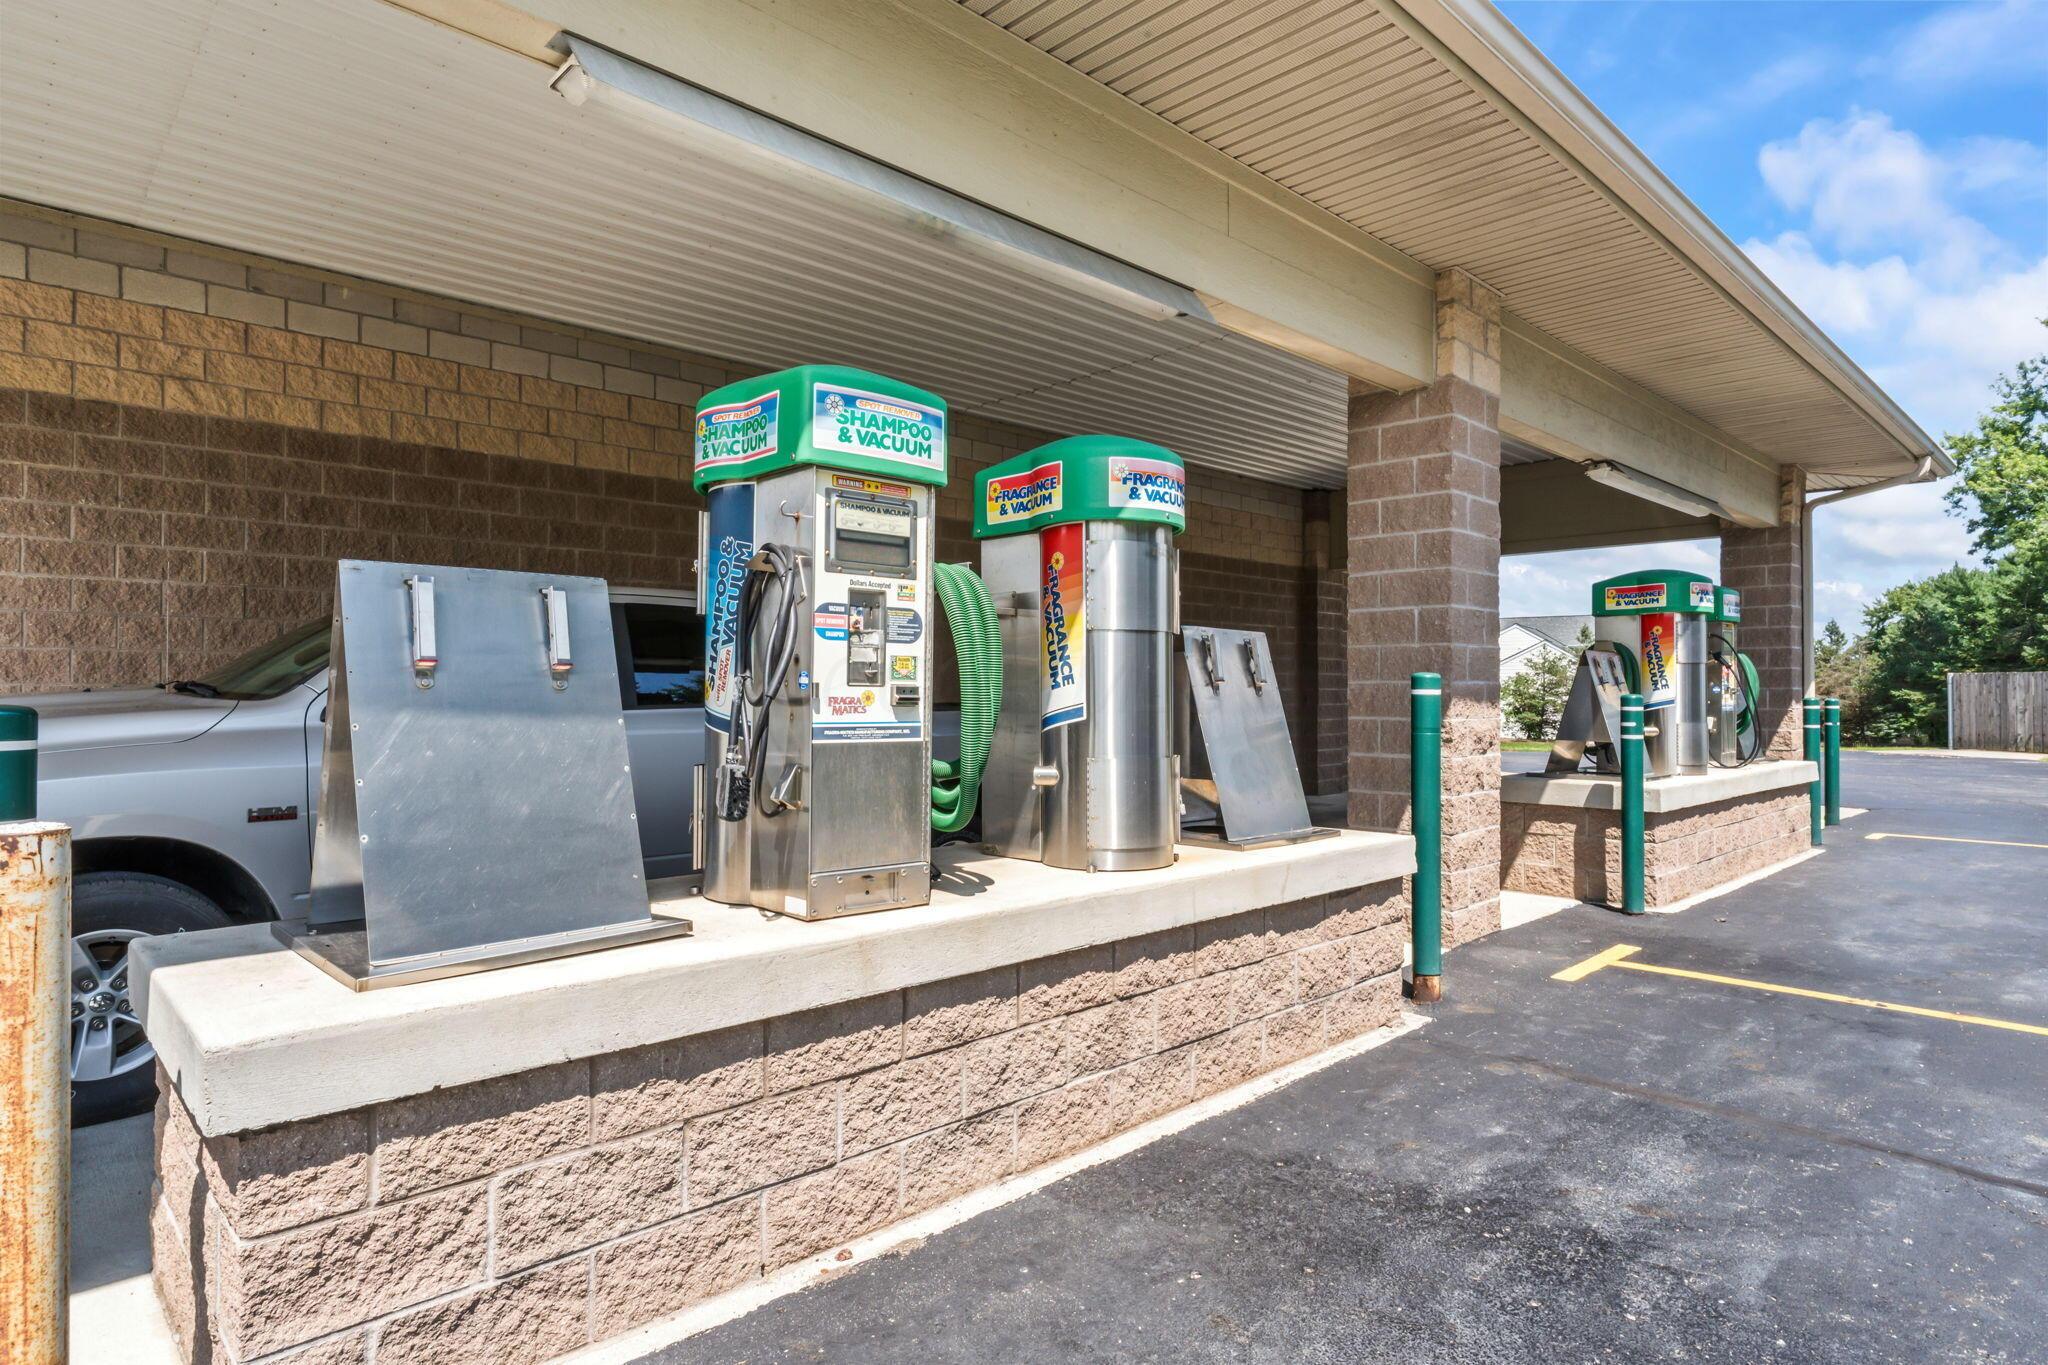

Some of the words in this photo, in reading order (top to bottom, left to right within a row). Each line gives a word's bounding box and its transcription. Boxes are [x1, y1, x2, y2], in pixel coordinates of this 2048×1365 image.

[713, 413, 732, 423] SPOT
[733, 406, 761, 419] REMOVER
[858, 400, 880, 412] SPOT
[882, 404, 921, 419] REMOVER
[701, 414, 768, 444] SHAMPOO
[836, 408, 932, 442] SHAMPOO
[702, 444, 709, 460] &
[711, 431, 767, 458] VACUUM
[837, 426, 852, 444] &
[855, 428, 932, 459] VACUUM
[837, 478, 864, 488] WARNING
[994, 477, 1057, 503] FRAGRANCE
[1122, 472, 1185, 496] FRAGRAN
[1129, 486, 1141, 500] &
[840, 502, 876, 514] SHAMPOO
[882, 508, 910, 517] VACUUM
[1000, 503, 1008, 516] &
[1011, 492, 1053, 514] VACUUM
[720, 540, 753, 646] VACUUM
[850, 579, 867, 587] Dollars
[868, 580, 891, 589] Accepted
[1612, 590, 1663, 600] FRAGRANCE
[706, 558, 731, 692] SHAMPOO
[720, 535, 734, 557] &
[1624, 597, 1660, 606] VACUUM
[1048, 564, 1075, 687] FRAGRANCE
[1043, 602, 1062, 690] VACUUM
[721, 648, 732, 693] REMOVER
[1646, 649, 1660, 692] VACUUM
[1649, 631, 1670, 690] FRAGRANCE
[827, 696, 863, 707] FRAGRA
[832, 705, 867, 716] MATICS
